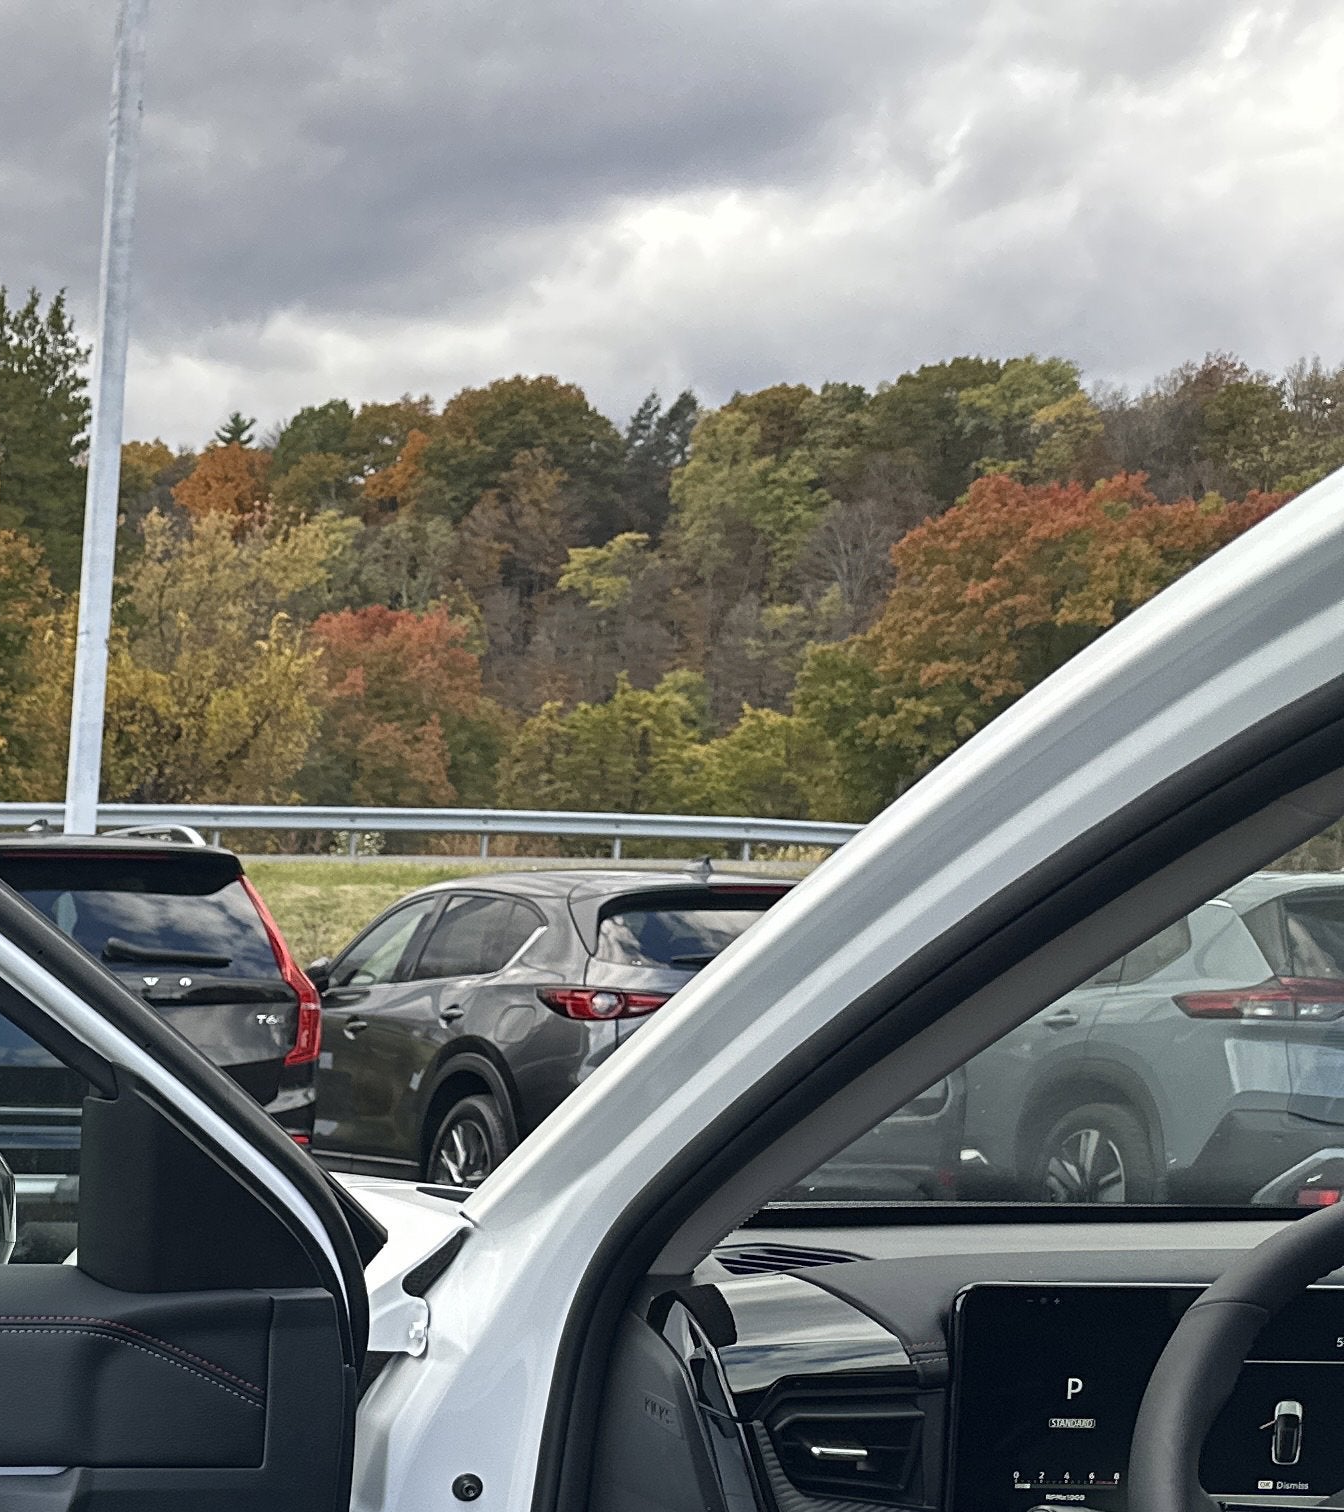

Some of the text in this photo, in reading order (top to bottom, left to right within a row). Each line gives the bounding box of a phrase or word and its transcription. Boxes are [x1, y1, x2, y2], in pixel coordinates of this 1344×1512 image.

[1066, 1377, 1084, 1400] P
[1039, 1471, 1045, 1480] 2
[1064, 1471, 1070, 1480] 4
[1088, 1471, 1095, 1480] 6
[1276, 1480, 1309, 1490] Dismiss
